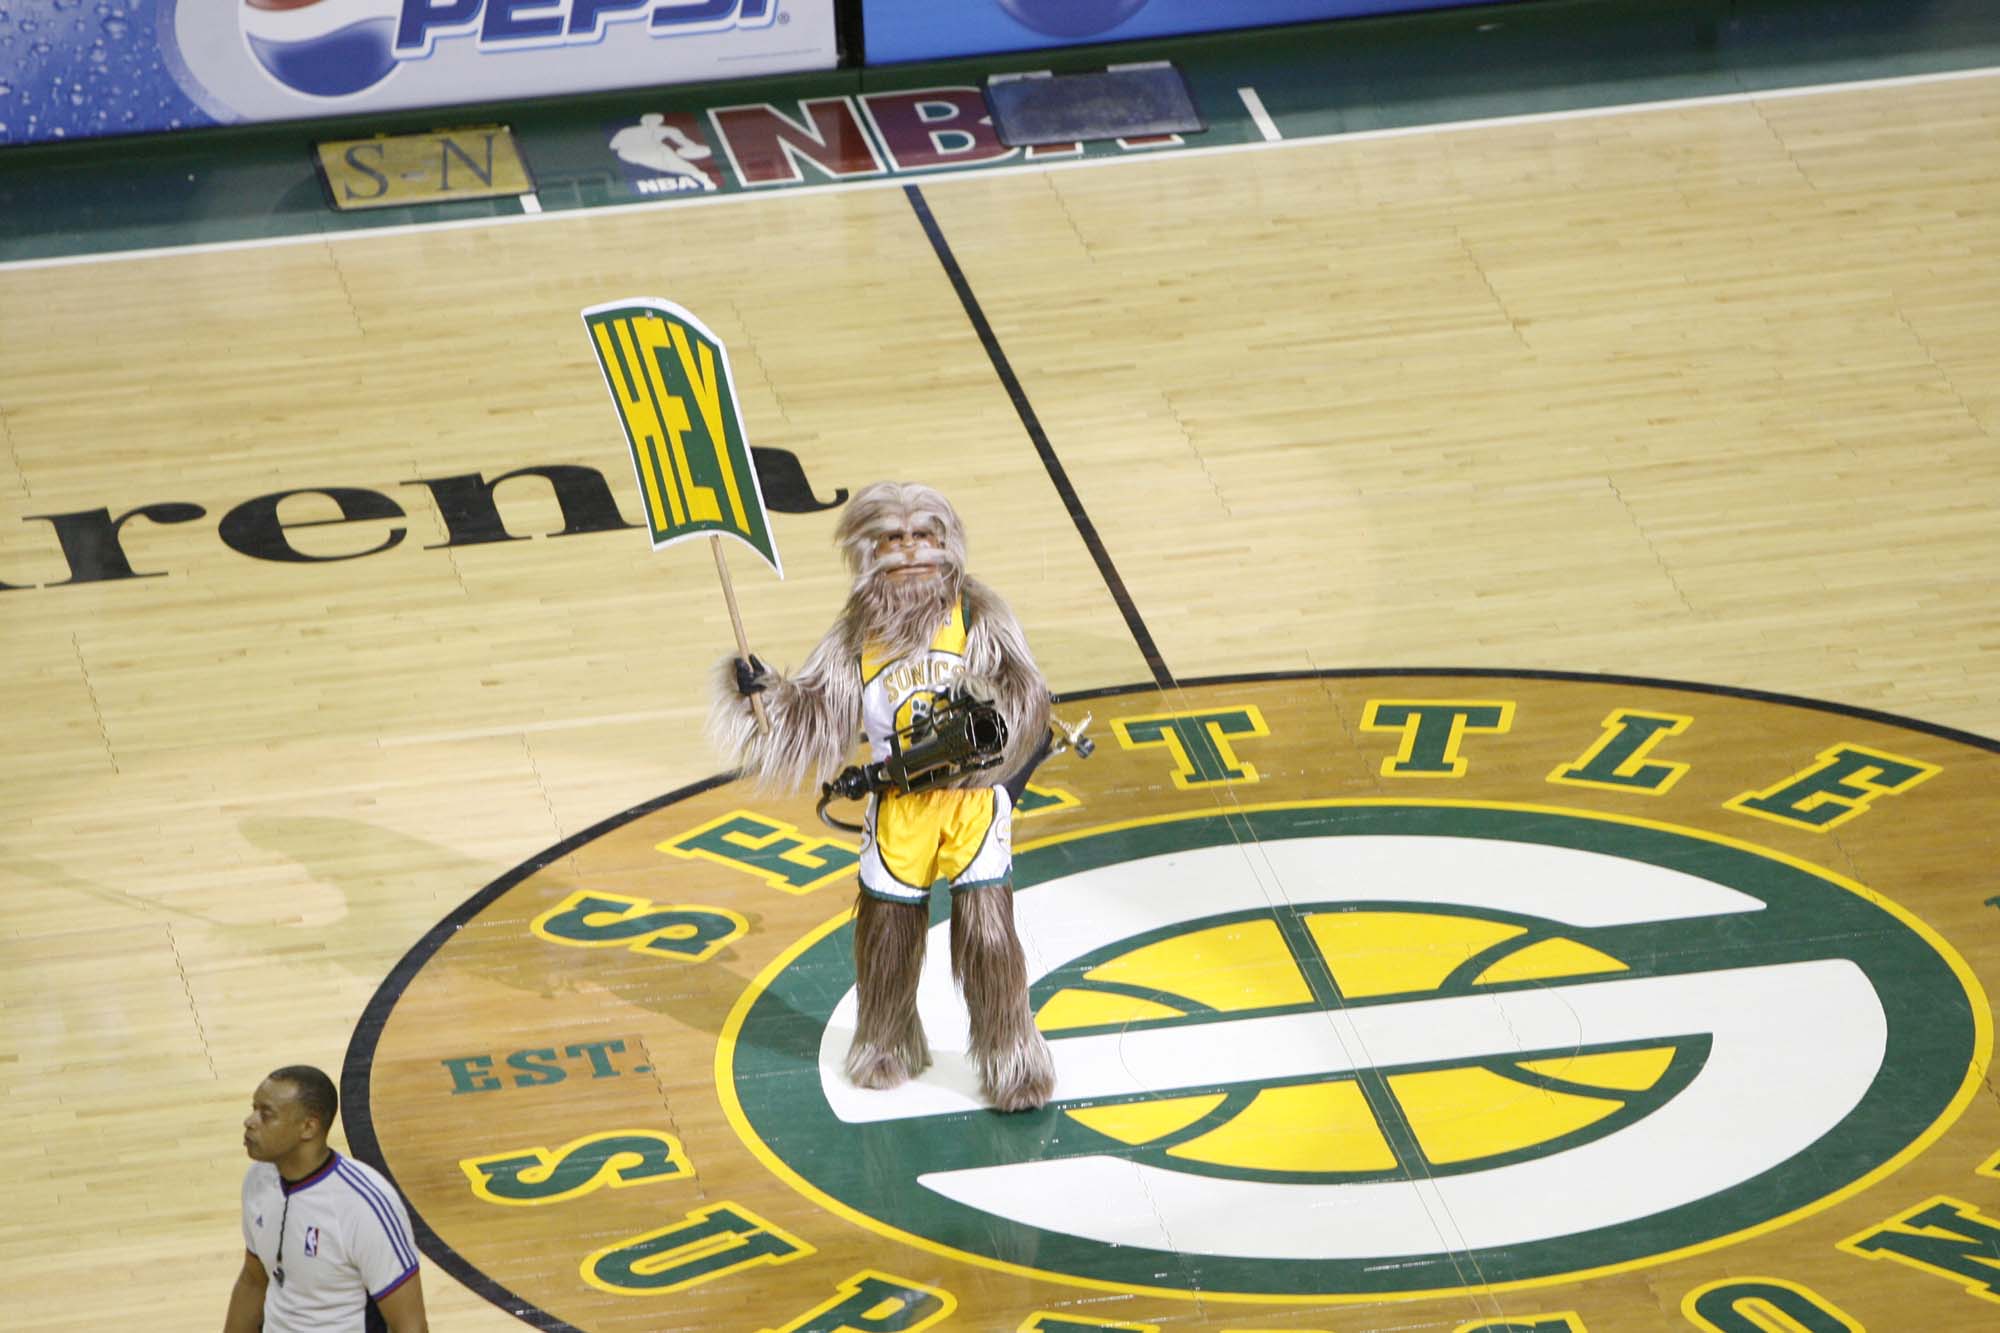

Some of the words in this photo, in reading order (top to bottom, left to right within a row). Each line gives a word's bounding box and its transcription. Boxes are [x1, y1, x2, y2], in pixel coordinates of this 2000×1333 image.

[637, 175, 699, 194] NBA
[706, 86, 1184, 187] NB
[593, 316, 751, 537] HEY
[530, 699, 1943, 963] SETTLE
[441, 1039, 651, 1095] EST.
